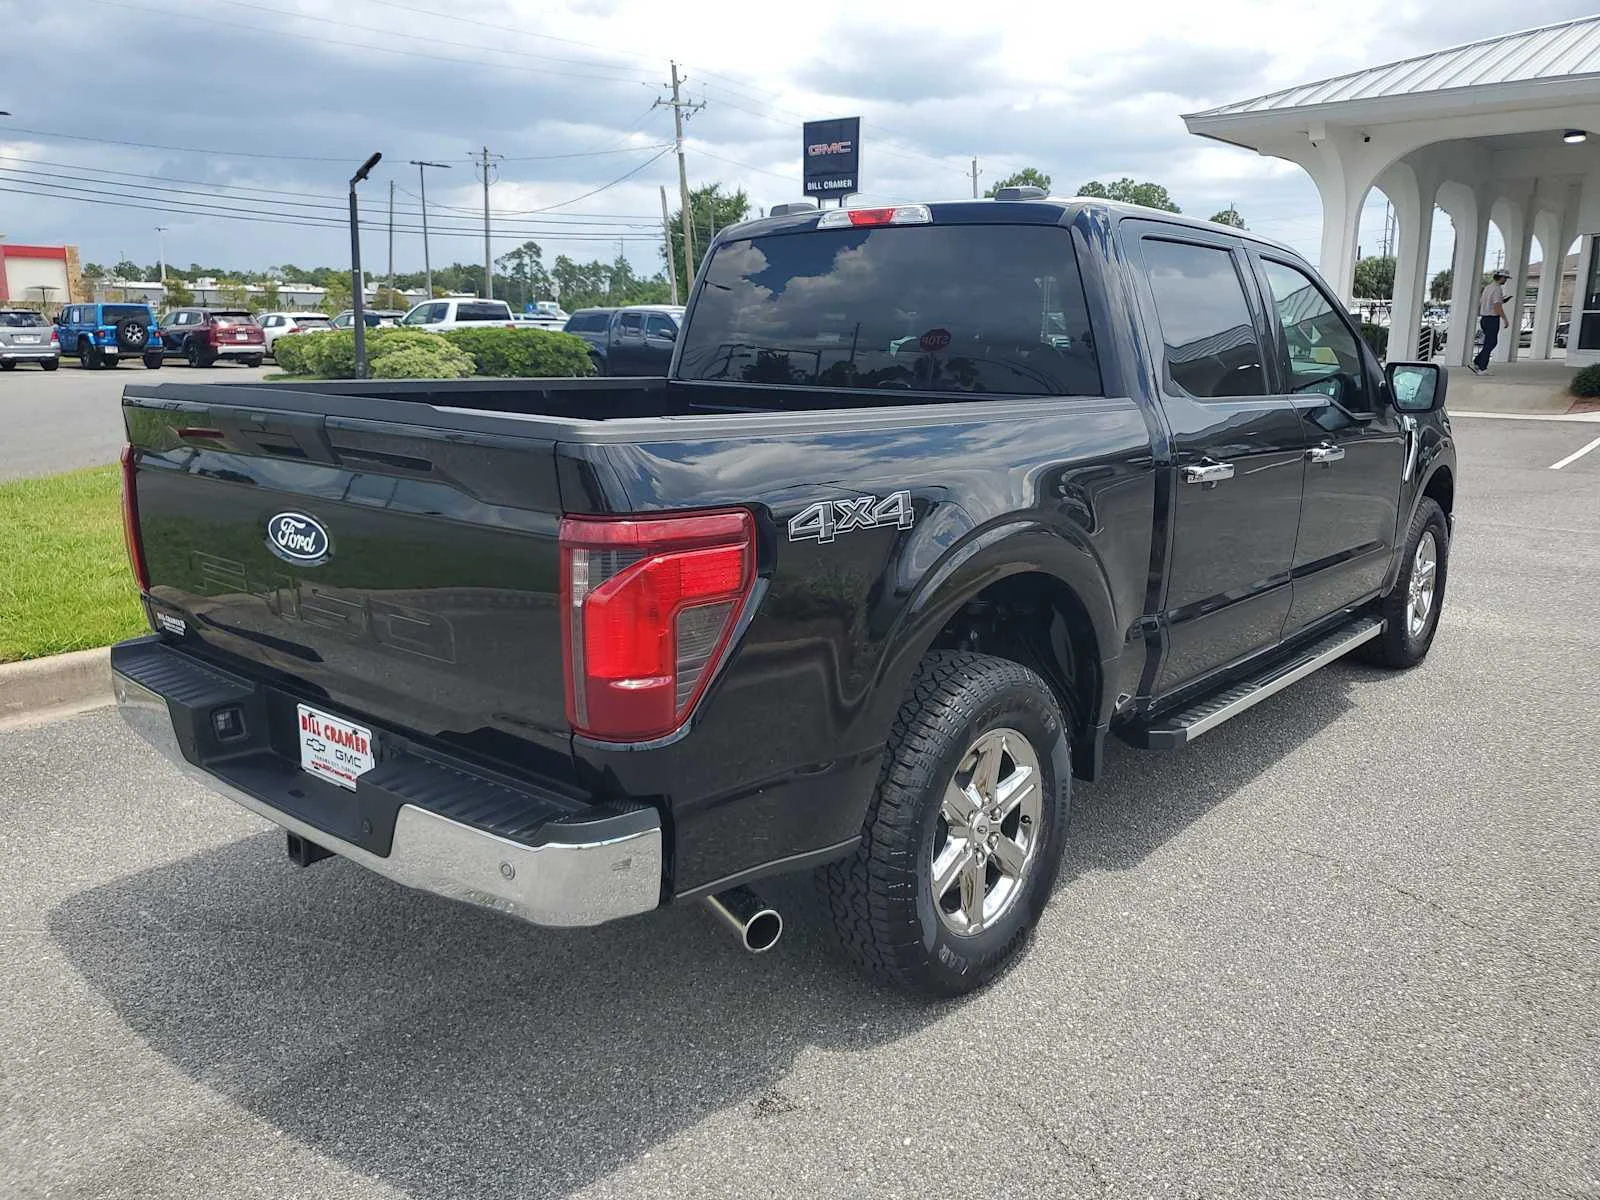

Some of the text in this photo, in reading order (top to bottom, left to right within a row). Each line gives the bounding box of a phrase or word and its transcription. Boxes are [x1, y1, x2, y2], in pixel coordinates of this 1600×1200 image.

[808, 141, 852, 156] GMC
[807, 179, 853, 191] BILL CRAMER
[278, 517, 316, 553] Ford
[301, 715, 368, 756] BILL CRAMER
[335, 748, 362, 769] GMC
